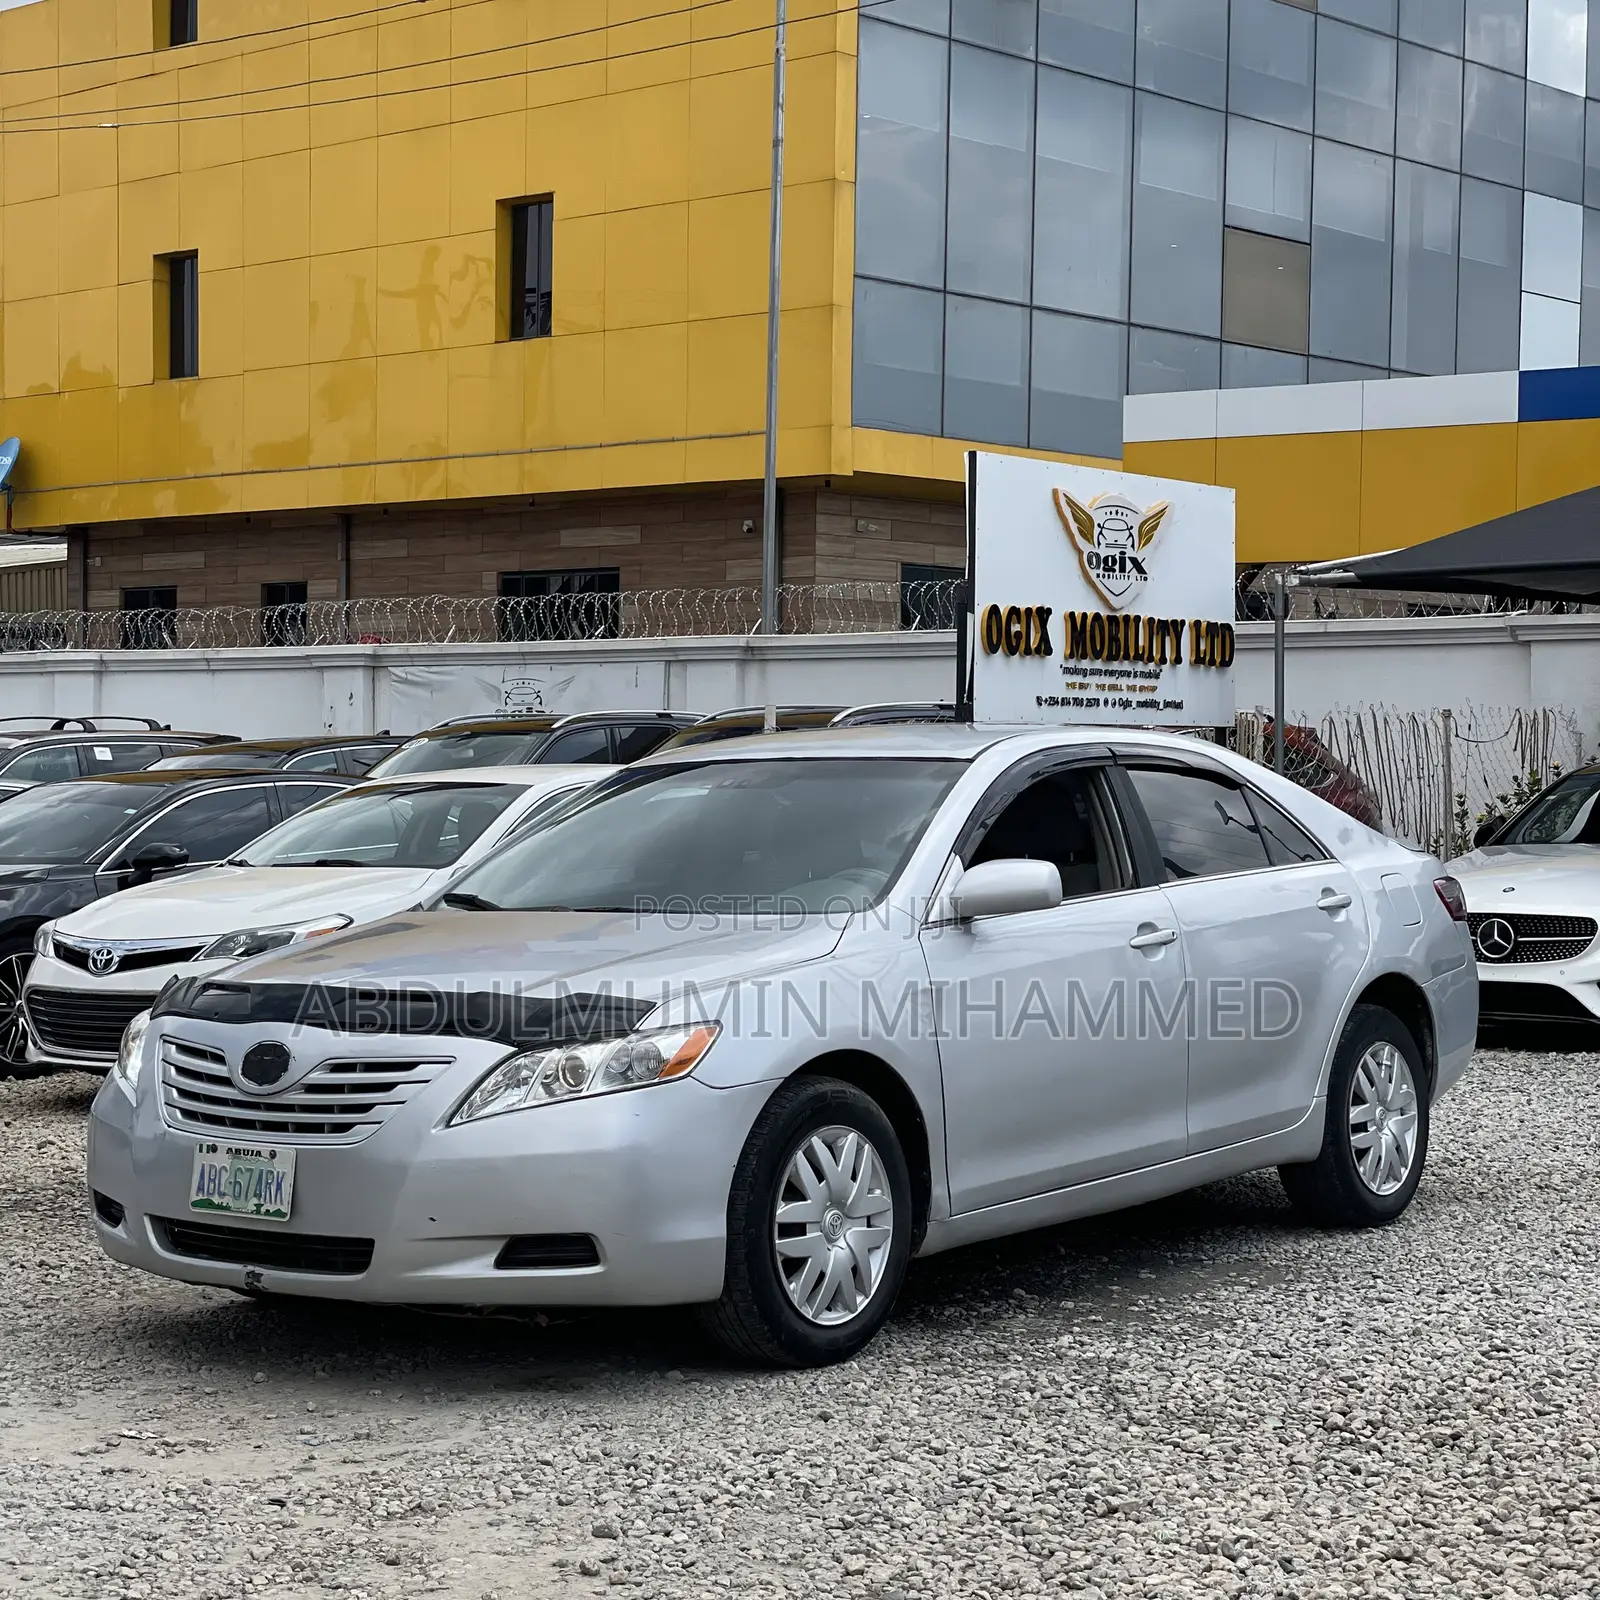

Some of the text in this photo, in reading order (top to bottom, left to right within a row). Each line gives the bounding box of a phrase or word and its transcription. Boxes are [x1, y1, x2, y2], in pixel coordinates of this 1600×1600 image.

[1087, 550, 1148, 575] Ogix
[1096, 573, 1131, 581] MOBILITY
[981, 603, 1235, 668] OGIX MOBILITY LTD
[1089, 667, 1103, 677] sure
[1104, 668, 1132, 679] everyone
[1132, 668, 1139, 678] is
[1065, 682, 1077, 690] WE
[1095, 683, 1107, 691] WE
[1126, 684, 1138, 692] WE
[226, 1147, 263, 1158] ABUJA
